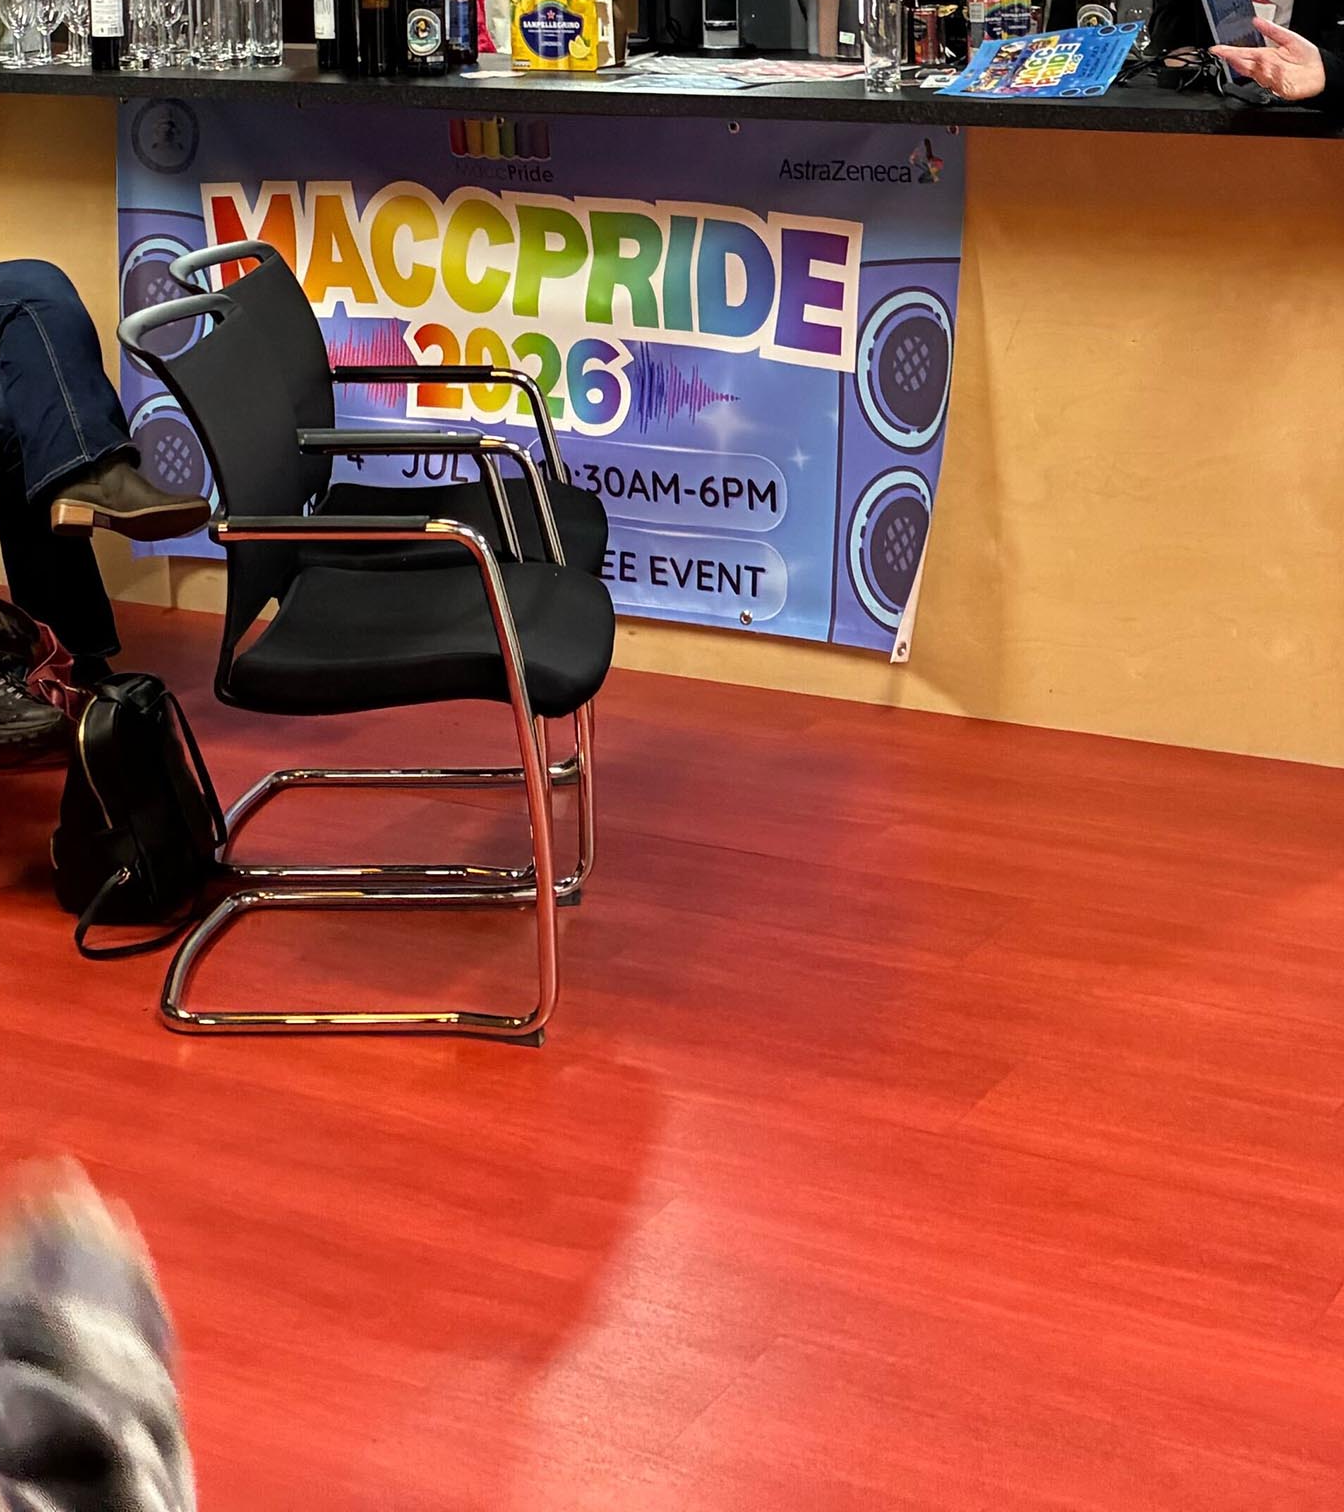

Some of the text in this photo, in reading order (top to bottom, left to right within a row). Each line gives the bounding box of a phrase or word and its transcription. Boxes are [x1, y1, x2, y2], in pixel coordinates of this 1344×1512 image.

[1034, 42, 1079, 86] PRIDE
[778, 158, 912, 183] AstraZeneca
[206, 187, 854, 362] MACCPRIDE
[411, 320, 624, 429] 2026
[401, 453, 469, 483] JUL
[649, 555, 766, 598] EVENT
